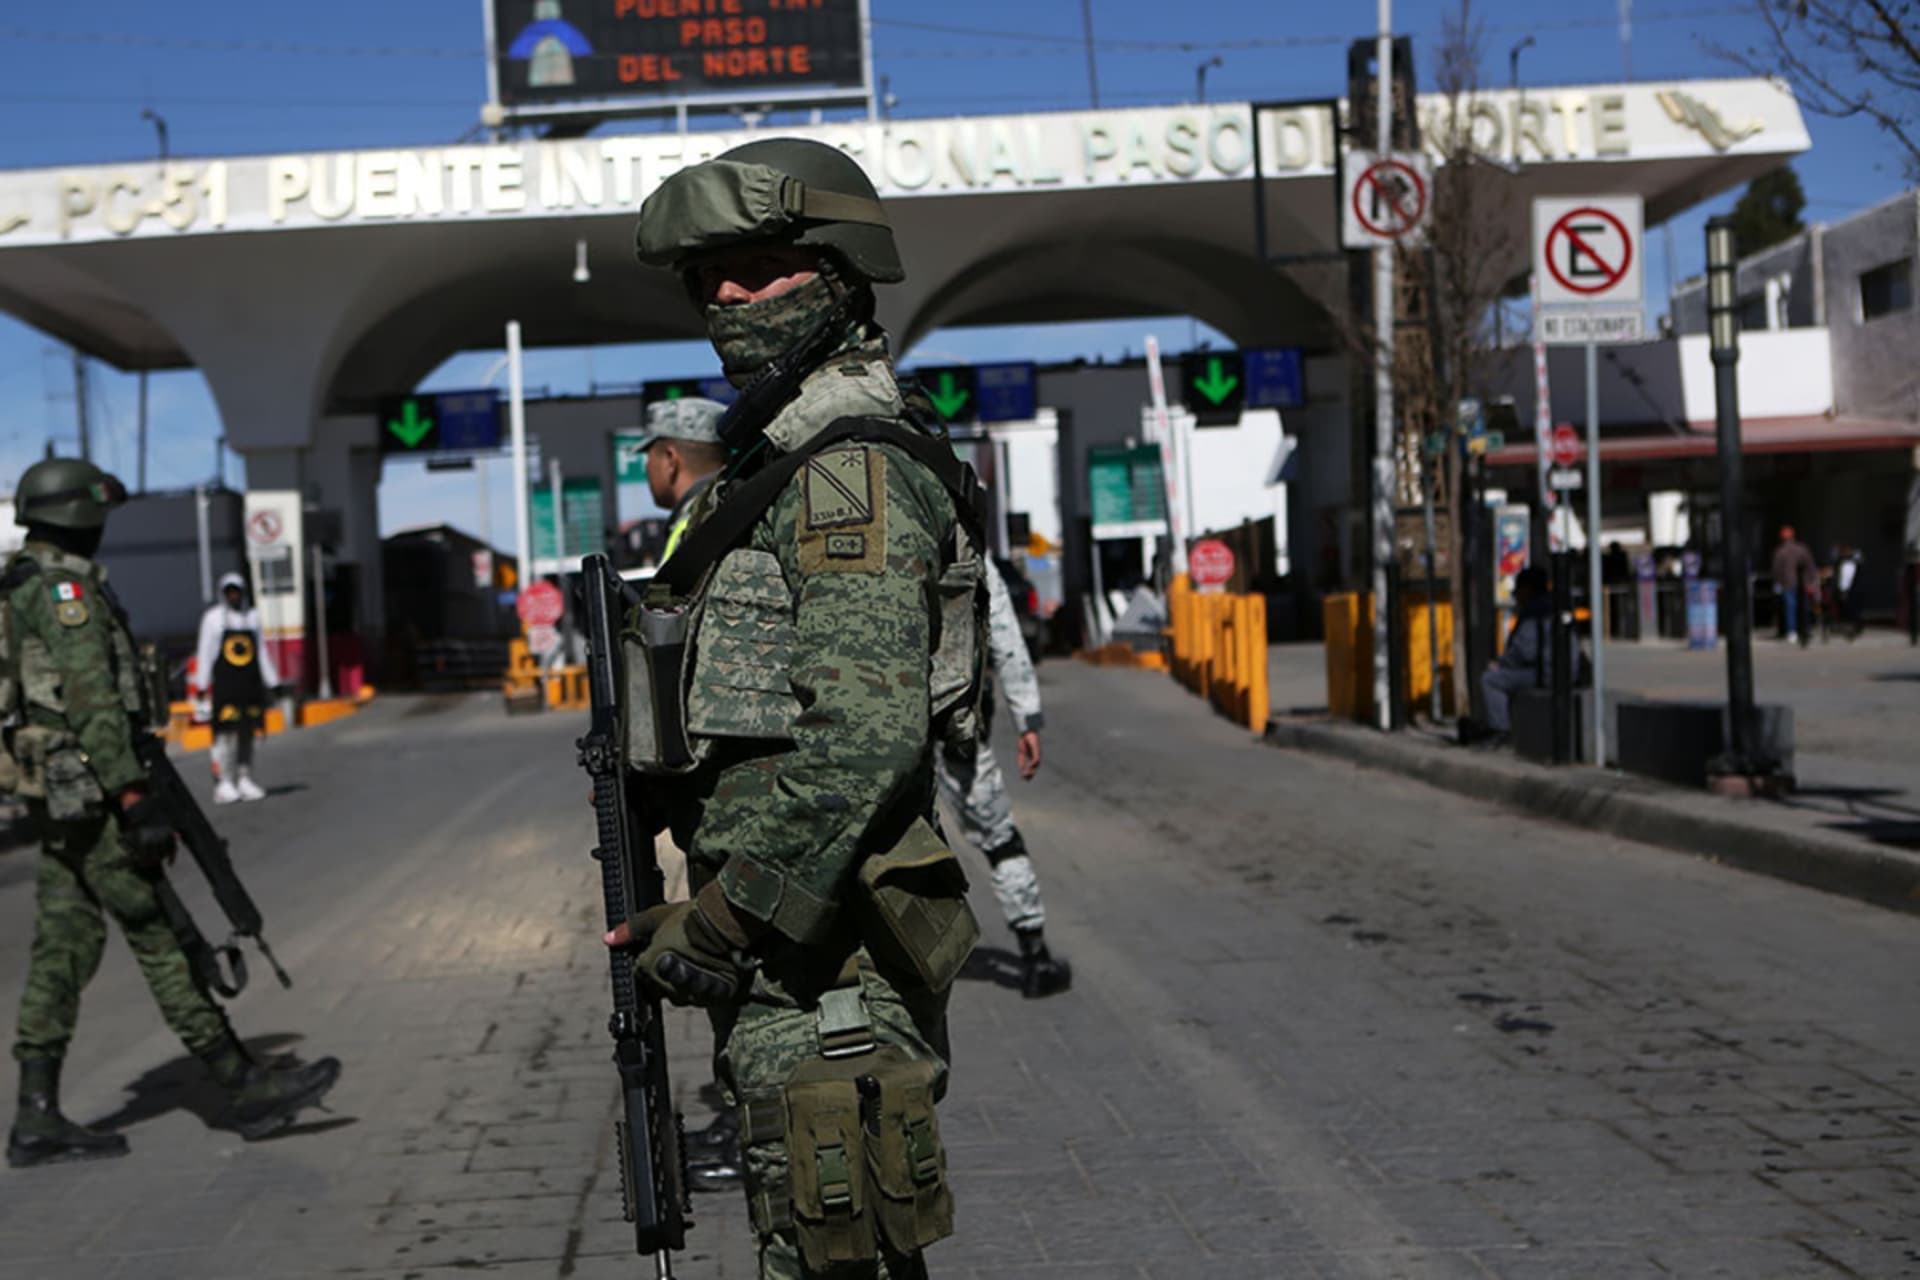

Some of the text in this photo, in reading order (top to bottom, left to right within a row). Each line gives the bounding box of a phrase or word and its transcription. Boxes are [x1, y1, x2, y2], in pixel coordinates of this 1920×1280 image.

[680, 16, 767, 46] PASO
[617, 45, 811, 83] DEL NORTE
[269, 146, 526, 224] PUENTE
[1084, 109, 1254, 182] PASO
